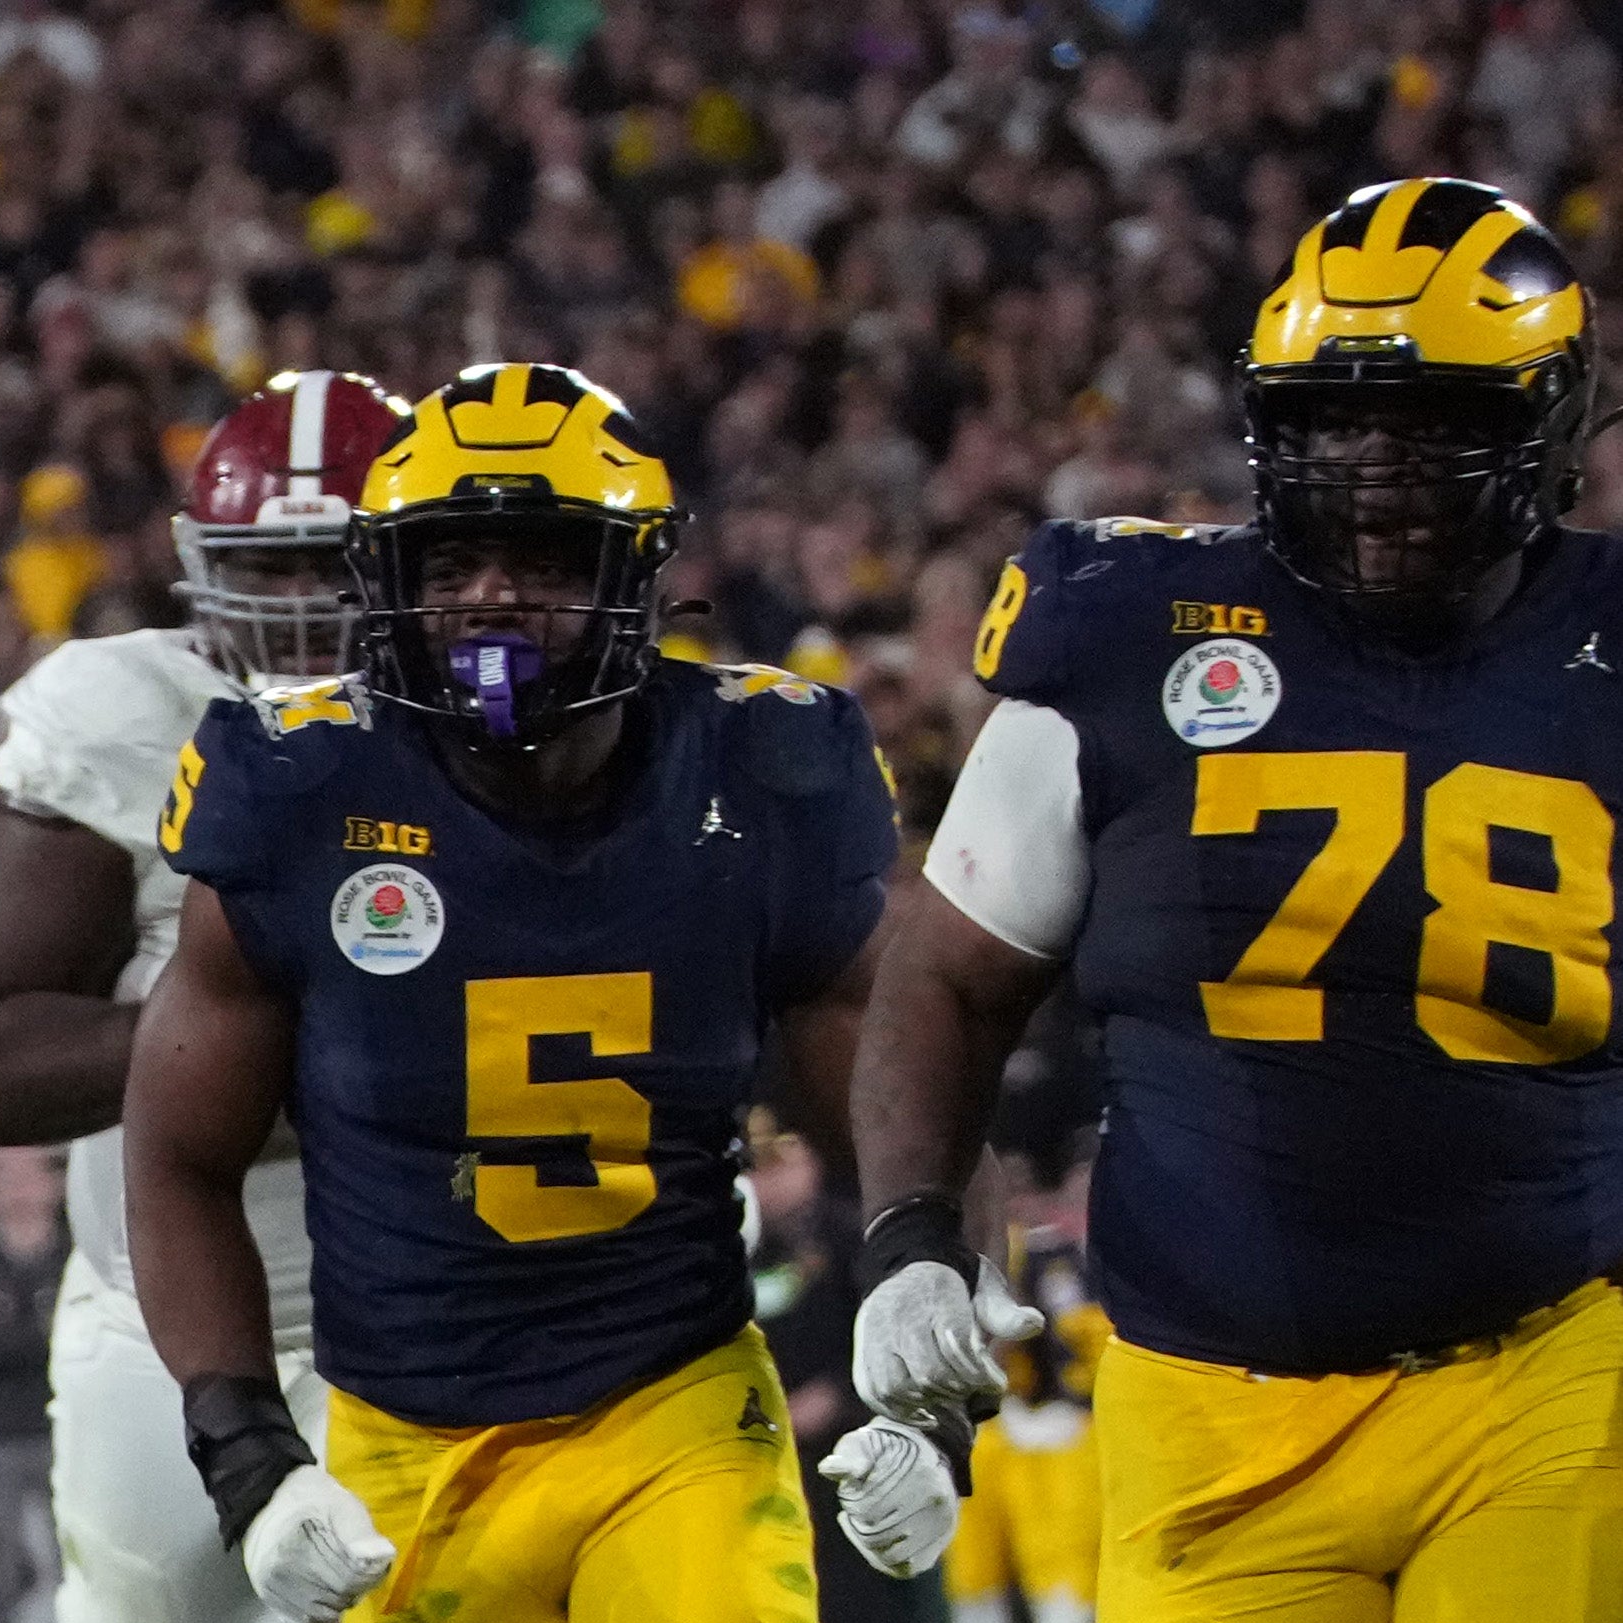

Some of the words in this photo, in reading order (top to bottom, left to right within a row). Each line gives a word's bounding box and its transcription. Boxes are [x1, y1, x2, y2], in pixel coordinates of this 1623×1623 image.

[973, 562, 1028, 681] 8
[159, 739, 207, 854] 5
[1191, 750, 1616, 1066] 78
[464, 971, 657, 1243] 5
